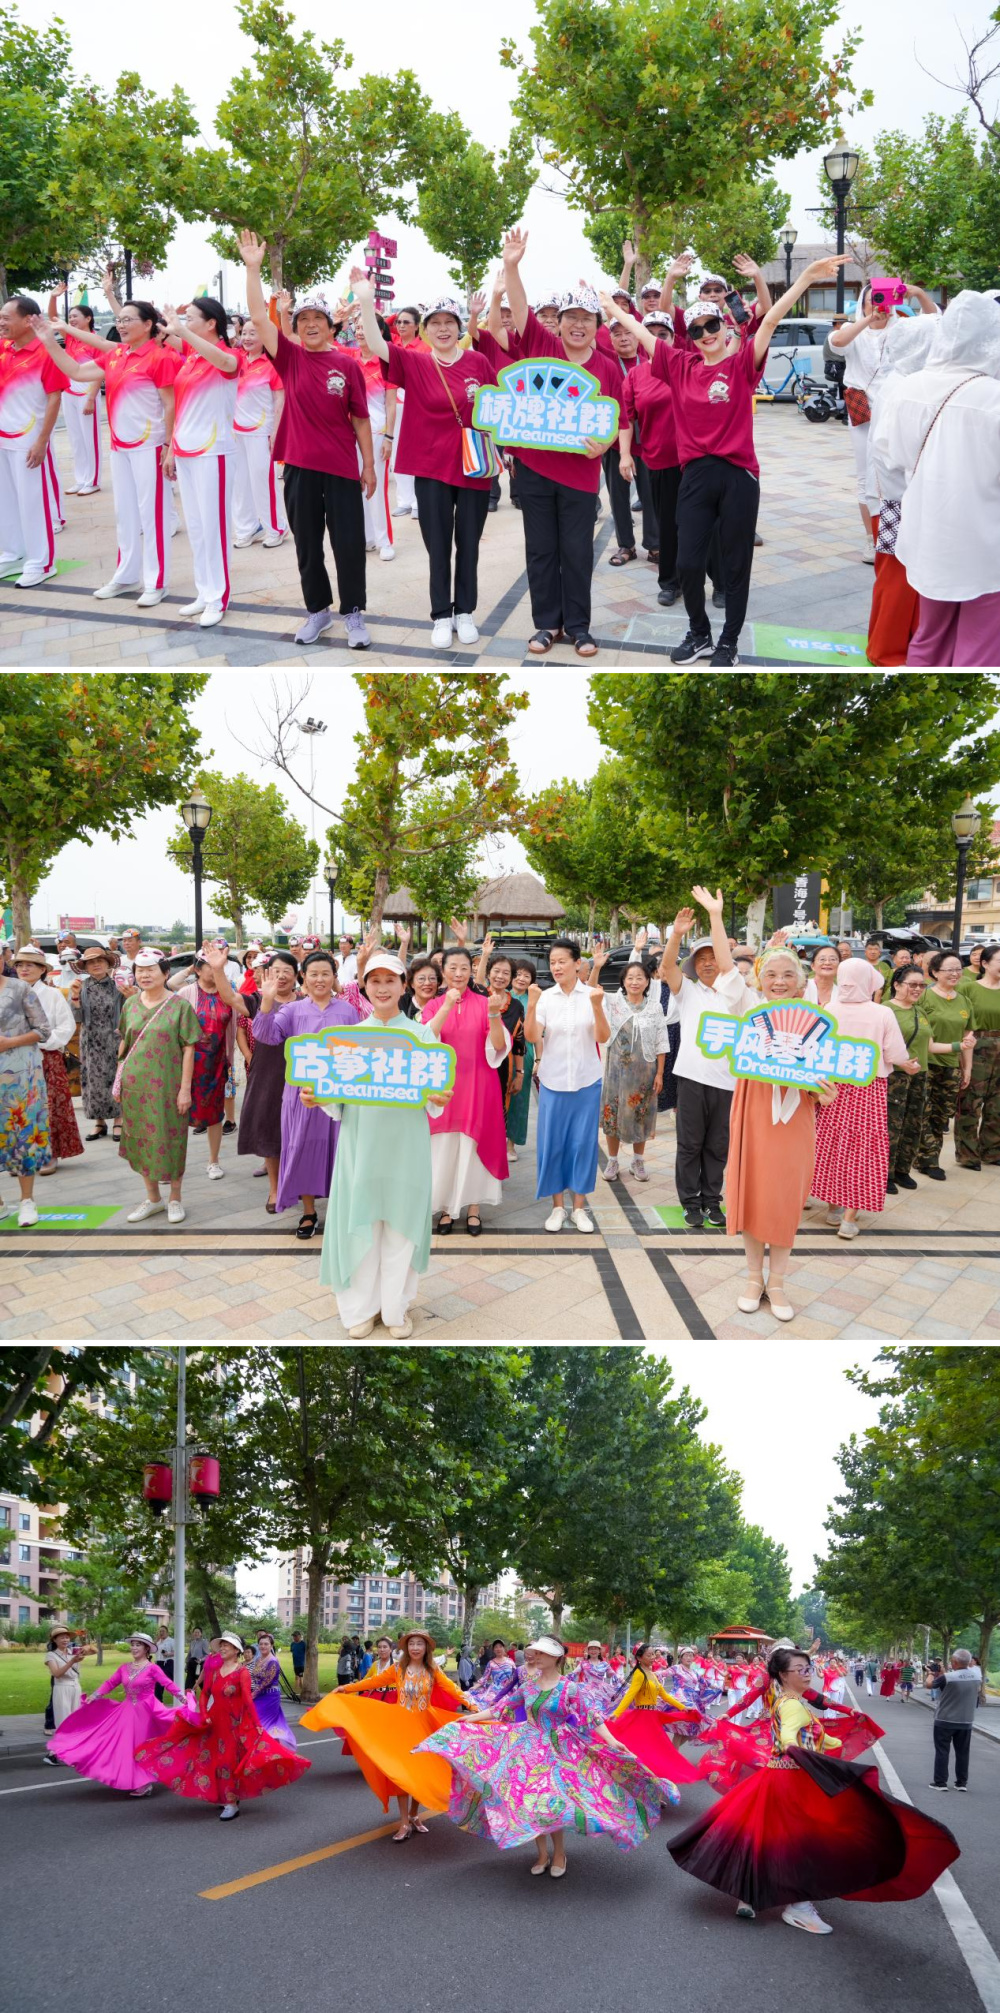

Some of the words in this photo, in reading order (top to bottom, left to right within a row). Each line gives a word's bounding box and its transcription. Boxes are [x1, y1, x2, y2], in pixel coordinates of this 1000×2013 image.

[480, 392, 612, 436] 桥牌社群
[294, 1042, 448, 1088] 古筝社群
[702, 1018, 873, 1079] 手风琴社群
[317, 1078, 420, 1101] Dreamsea
